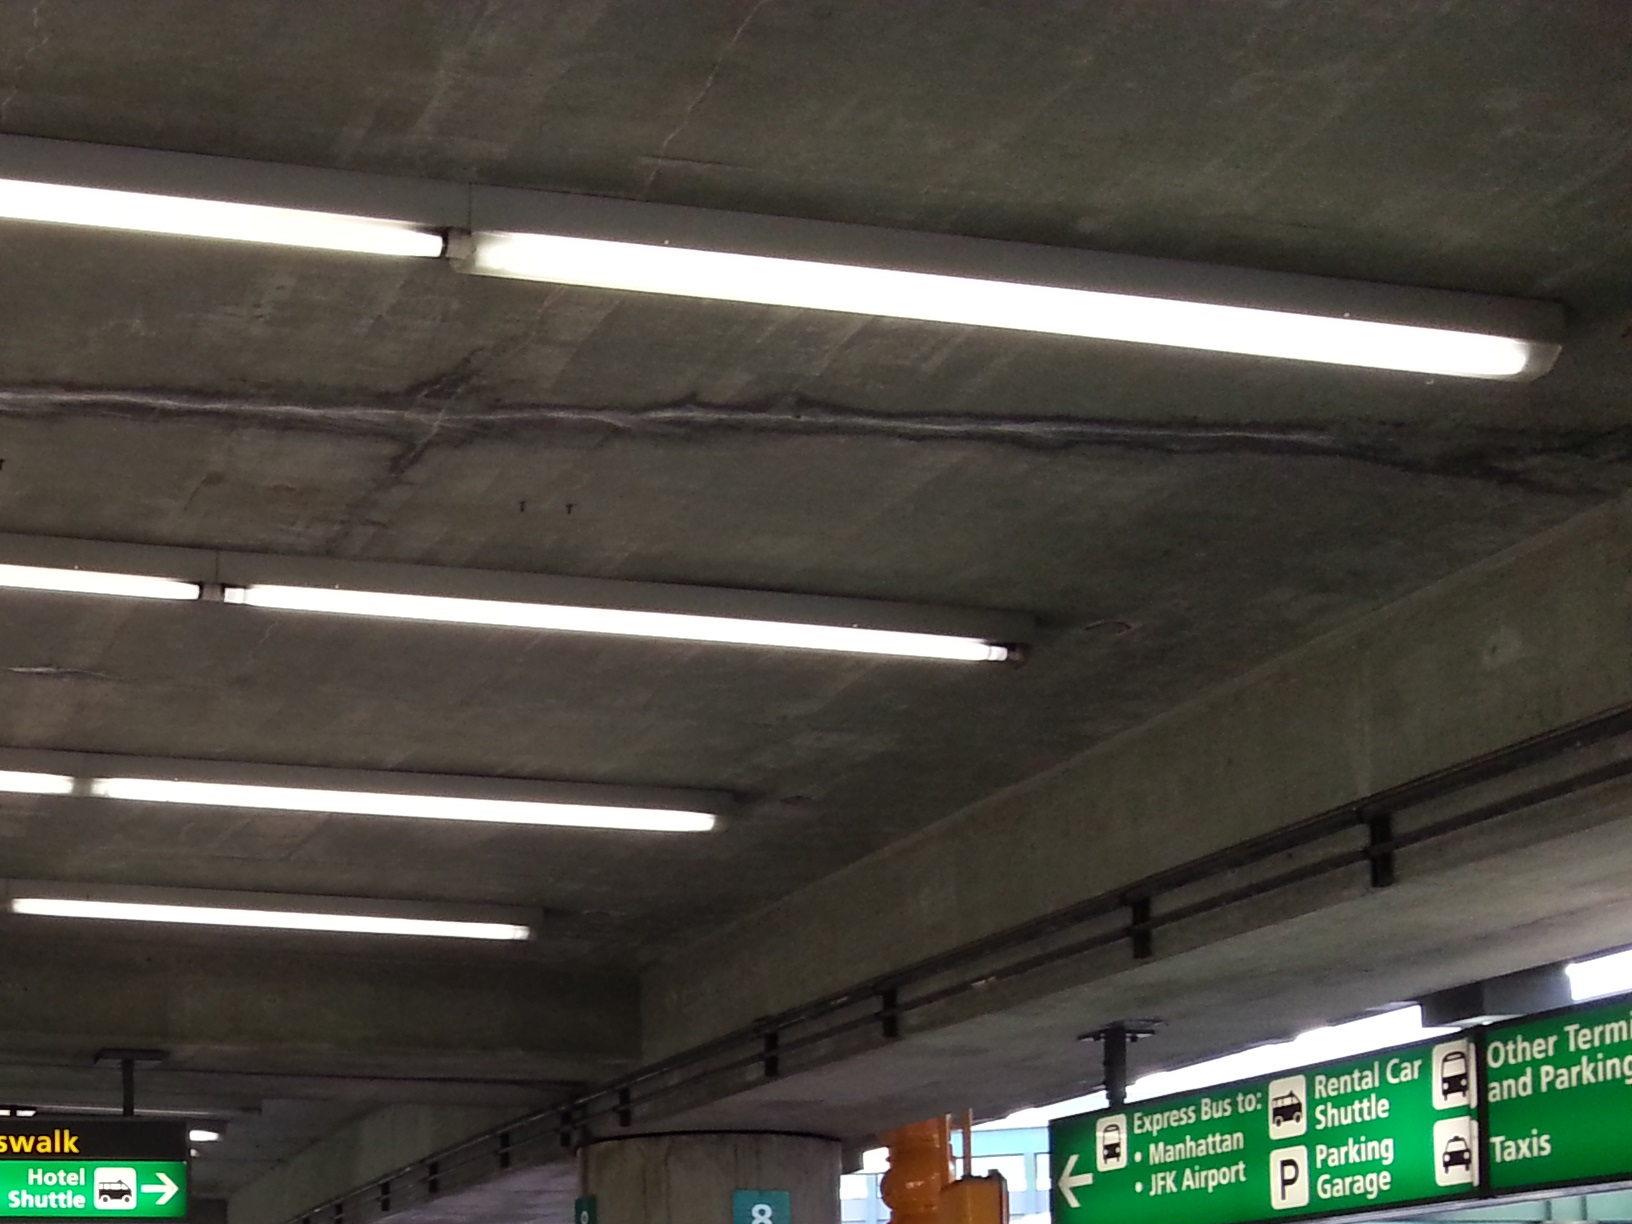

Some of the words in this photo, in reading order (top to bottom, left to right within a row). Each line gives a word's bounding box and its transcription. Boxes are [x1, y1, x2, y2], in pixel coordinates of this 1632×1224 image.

[1487, 1035, 1558, 1068] Other
[1314, 1061, 1380, 1099] Rental
[1386, 1058, 1422, 1084] Car
[1487, 1066, 1533, 1102] and
[1540, 1052, 1632, 1093] Parking
[1134, 1104, 1196, 1136] Express
[1200, 1097, 1233, 1119] Bus
[1237, 1091, 1262, 1112] to:
[1315, 1093, 1390, 1130] Shuttle
[1149, 1131, 1244, 1165] Manhattan
[1316, 1136, 1394, 1168] Parking
[1490, 1128, 1552, 1163] Taxis
[28, 1168, 85, 1186] Hotel
[1149, 1170, 1177, 1196] JFK
[1182, 1161, 1246, 1192] Airport
[1317, 1170, 1391, 1199] Garage
[8, 1190, 86, 1209] Shuttle
